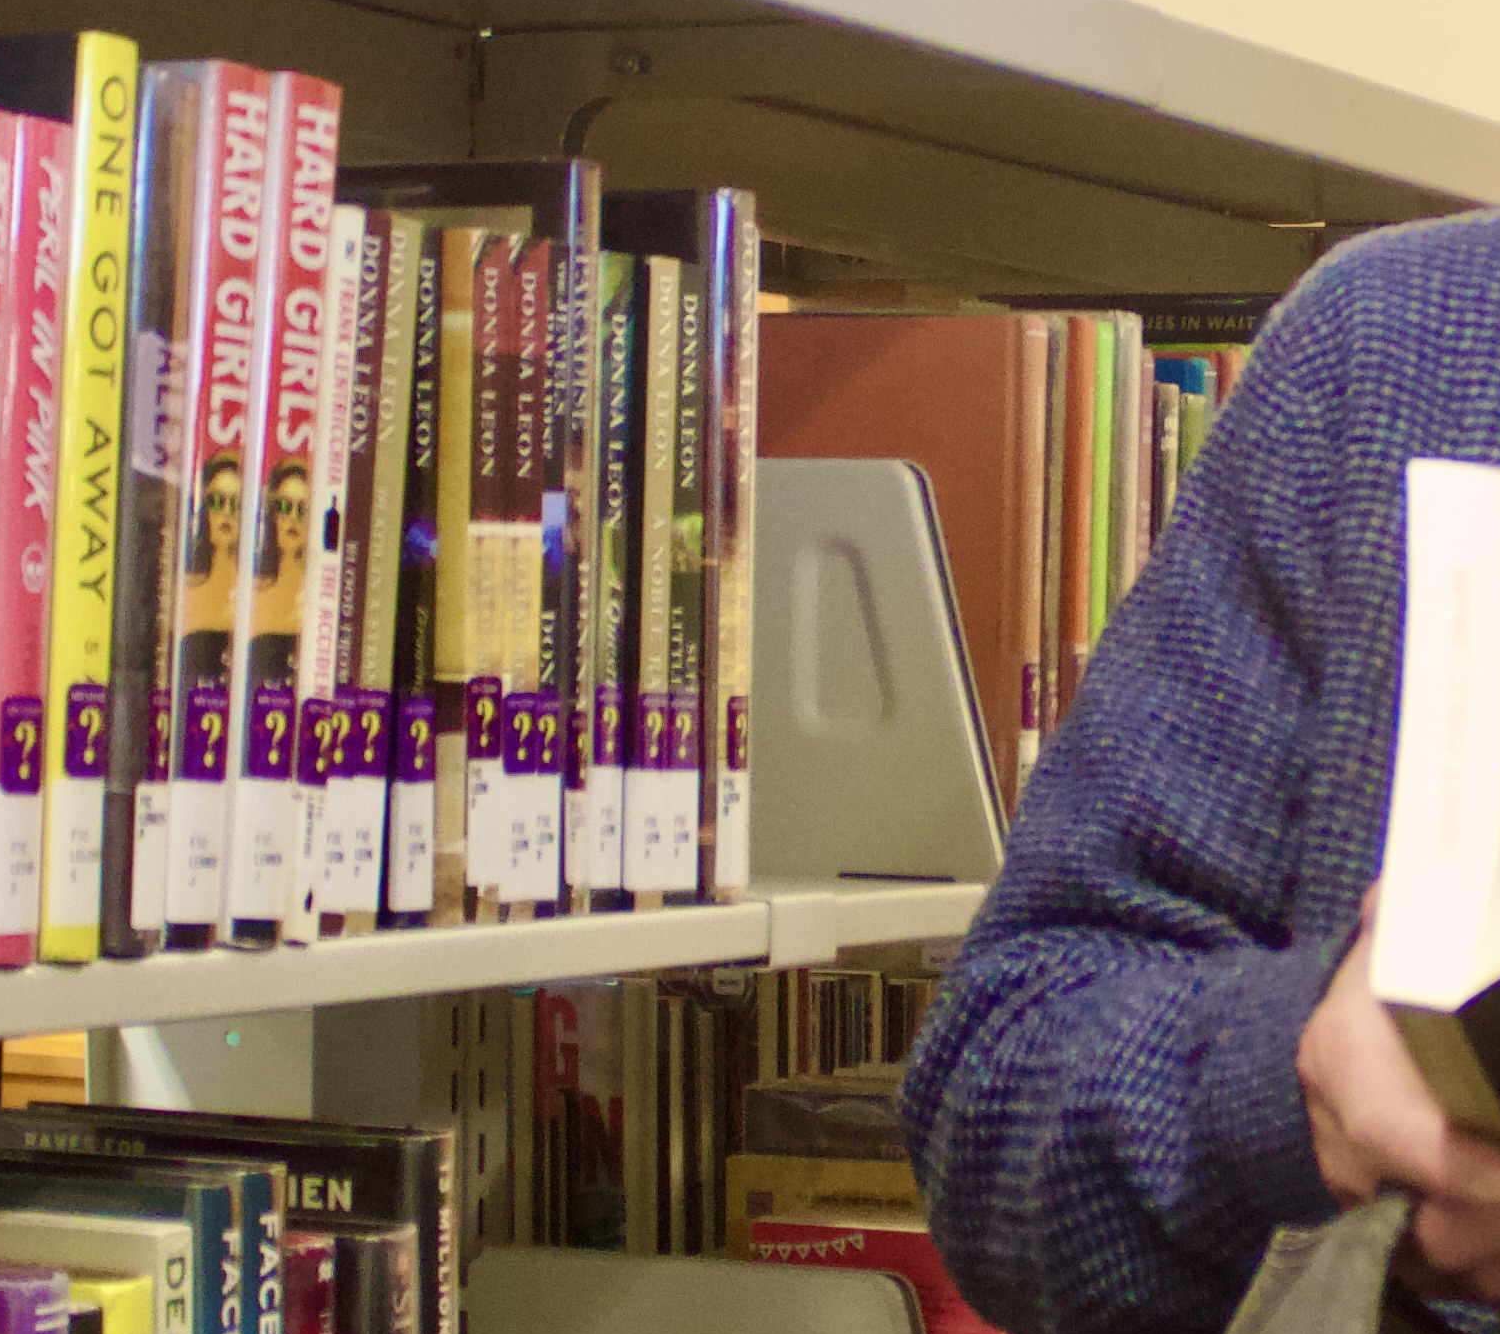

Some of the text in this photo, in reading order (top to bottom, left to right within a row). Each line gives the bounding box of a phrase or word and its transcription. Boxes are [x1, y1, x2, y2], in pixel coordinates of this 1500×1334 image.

[94, 74, 127, 218] ONE
[86, 250, 122, 387] GOT
[206, 89, 268, 448] HARD GIRLS
[274, 103, 338, 455] HARD GIRLS
[336, 276, 356, 345] FRANK
[353, 234, 382, 350] DONNA
[386, 228, 407, 341] DONNA
[657, 275, 673, 377] DONNA
[23, 156, 66, 521] PERIL IN PINK
[415, 256, 436, 469] DONNA LEON
[480, 266, 499, 477] DONNA LEON
[516, 271, 537, 478] DONNA LEON
[610, 313, 628, 429] DONNA
[682, 293, 699, 398] DONNA
[349, 365, 373, 455] LEON
[378, 357, 398, 443] LEON
[655, 389, 671, 470] LEON
[680, 407, 697, 490] LEON
[77, 416, 113, 605] AWAY
[604, 439, 625, 529] LEON
[319, 564, 338, 603] THE
